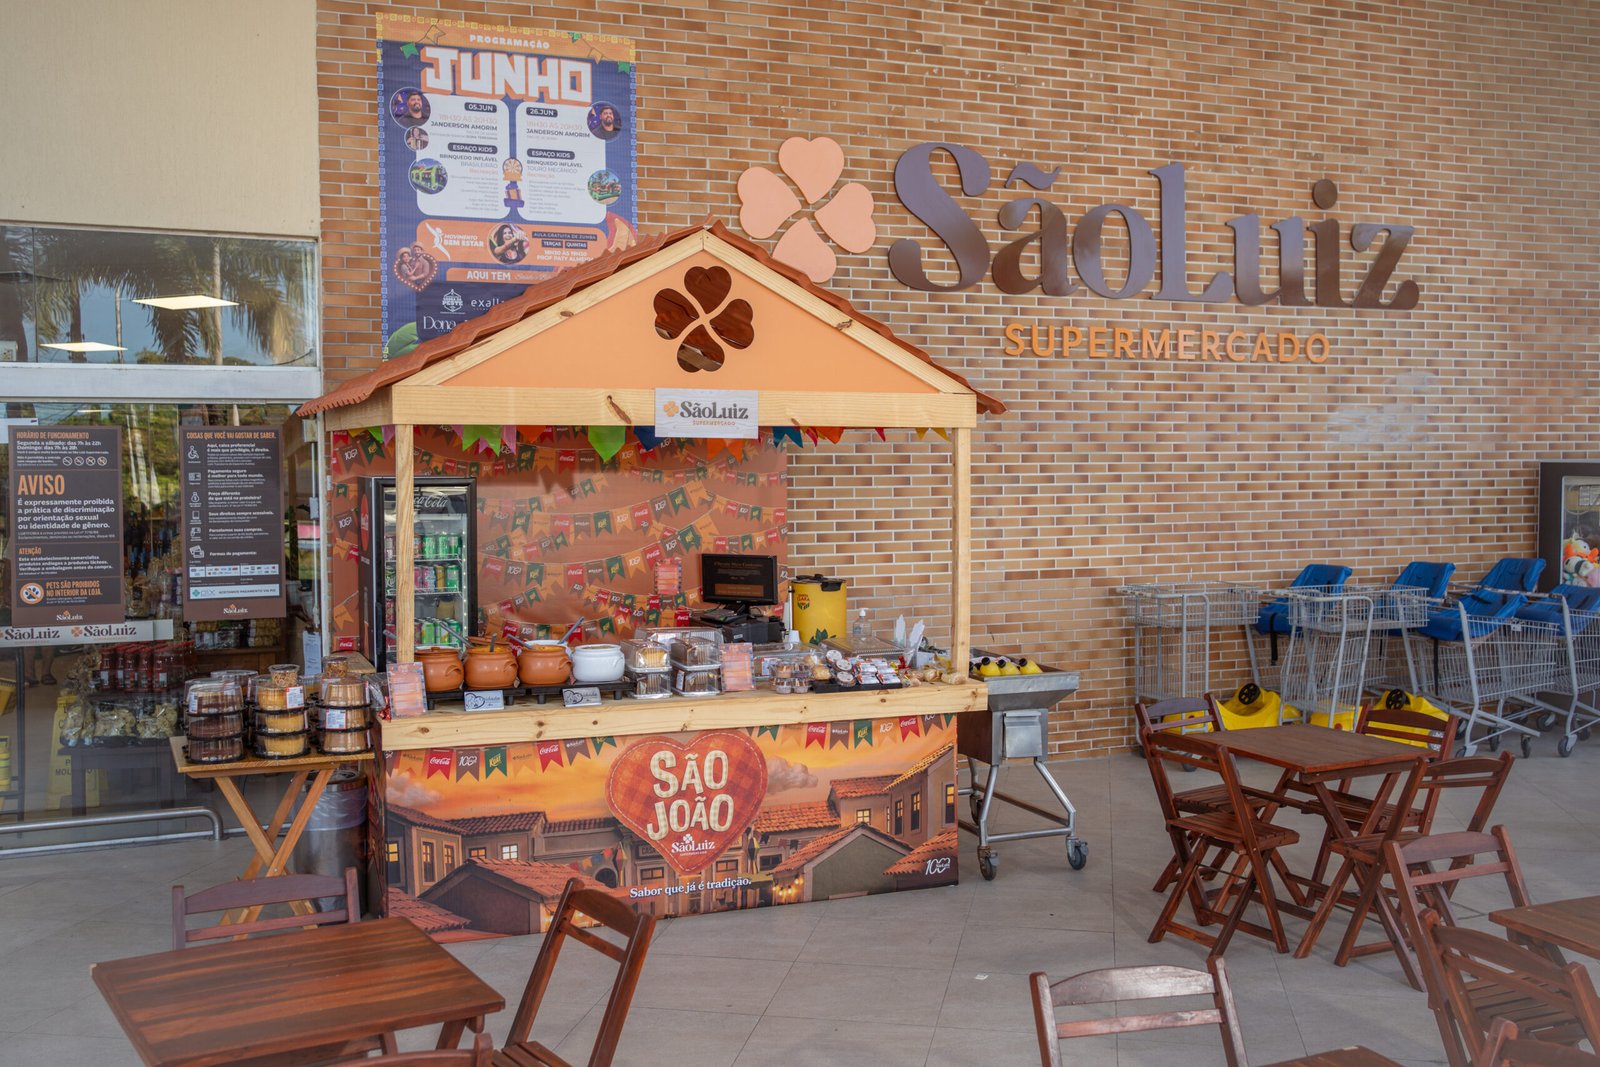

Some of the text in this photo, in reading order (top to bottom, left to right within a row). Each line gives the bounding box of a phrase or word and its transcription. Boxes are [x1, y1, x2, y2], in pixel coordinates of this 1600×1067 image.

[469, 34, 550, 50] PROGRAMAÇÃO
[422, 46, 592, 105] JUNHO
[468, 103, 494, 112] 05.JUN
[530, 108, 554, 116] 26.JUN
[430, 121, 470, 129] JANDERSON
[526, 128, 564, 137] JANDERSON
[452, 144, 477, 153] ESPAÇO
[531, 150, 556, 158] ESPAÇO
[888, 141, 1420, 310] SãoLuiz
[466, 271, 489, 280] AQUI
[491, 272, 511, 280] TEM
[423, 316, 457, 330] Dona
[1004, 322, 1331, 363] SUPERMERCADO
[680, 400, 749, 420] SãoLuiz
[16, 431, 40, 439] HORÁRIO
[47, 431, 89, 439] FUNCIONAMENTO
[204, 432, 213, 440] QUE
[214, 431, 226, 439] VOCÊ
[260, 431, 276, 439] SABER.
[17, 474, 65, 496] AVISO
[17, 498, 23, 506] É
[83, 498, 114, 506] proibida
[24, 507, 51, 515] prática
[63, 506, 115, 514] discriminação
[33, 514, 74, 522] orientação
[18, 546, 42, 556] ATENÇÃO
[60, 579, 71, 588] SÃO
[72, 580, 100, 588] PROIBIDOS
[55, 588, 79, 596] INTERIOR
[88, 588, 103, 596] LOJA.
[5, 627, 60, 641] SãoLuiz
[84, 624, 137, 638] SãoLuiz
[650, 749, 729, 798] SÃO
[646, 793, 734, 841] JOÃO
[671, 840, 715, 853] SãoLuiz
[629, 877, 752, 899] Sabor que já é tradição.
